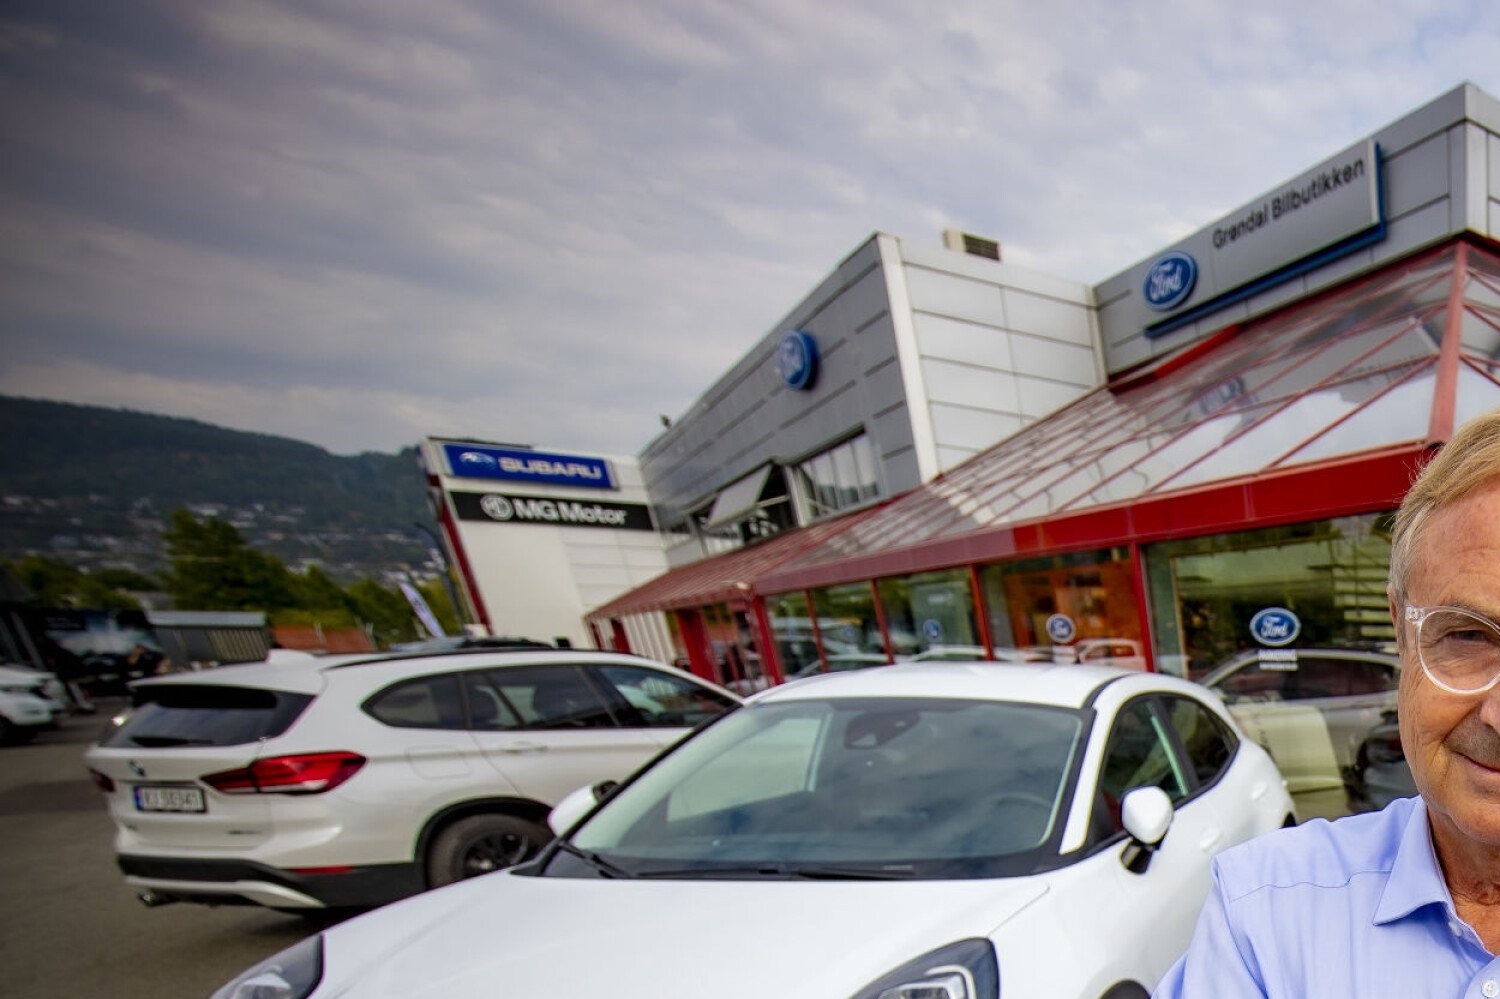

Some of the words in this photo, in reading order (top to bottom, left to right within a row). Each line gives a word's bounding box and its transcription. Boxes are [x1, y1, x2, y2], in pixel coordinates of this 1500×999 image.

[1212, 203, 1270, 249] Grøndal
[1271, 157, 1365, 221] Bilbutikken
[1151, 261, 1183, 302] Ford
[498, 456, 602, 481] SUBARU
[512, 498, 559, 521] MG
[557, 501, 628, 525] Motor
[1260, 615, 1290, 638] Ford
